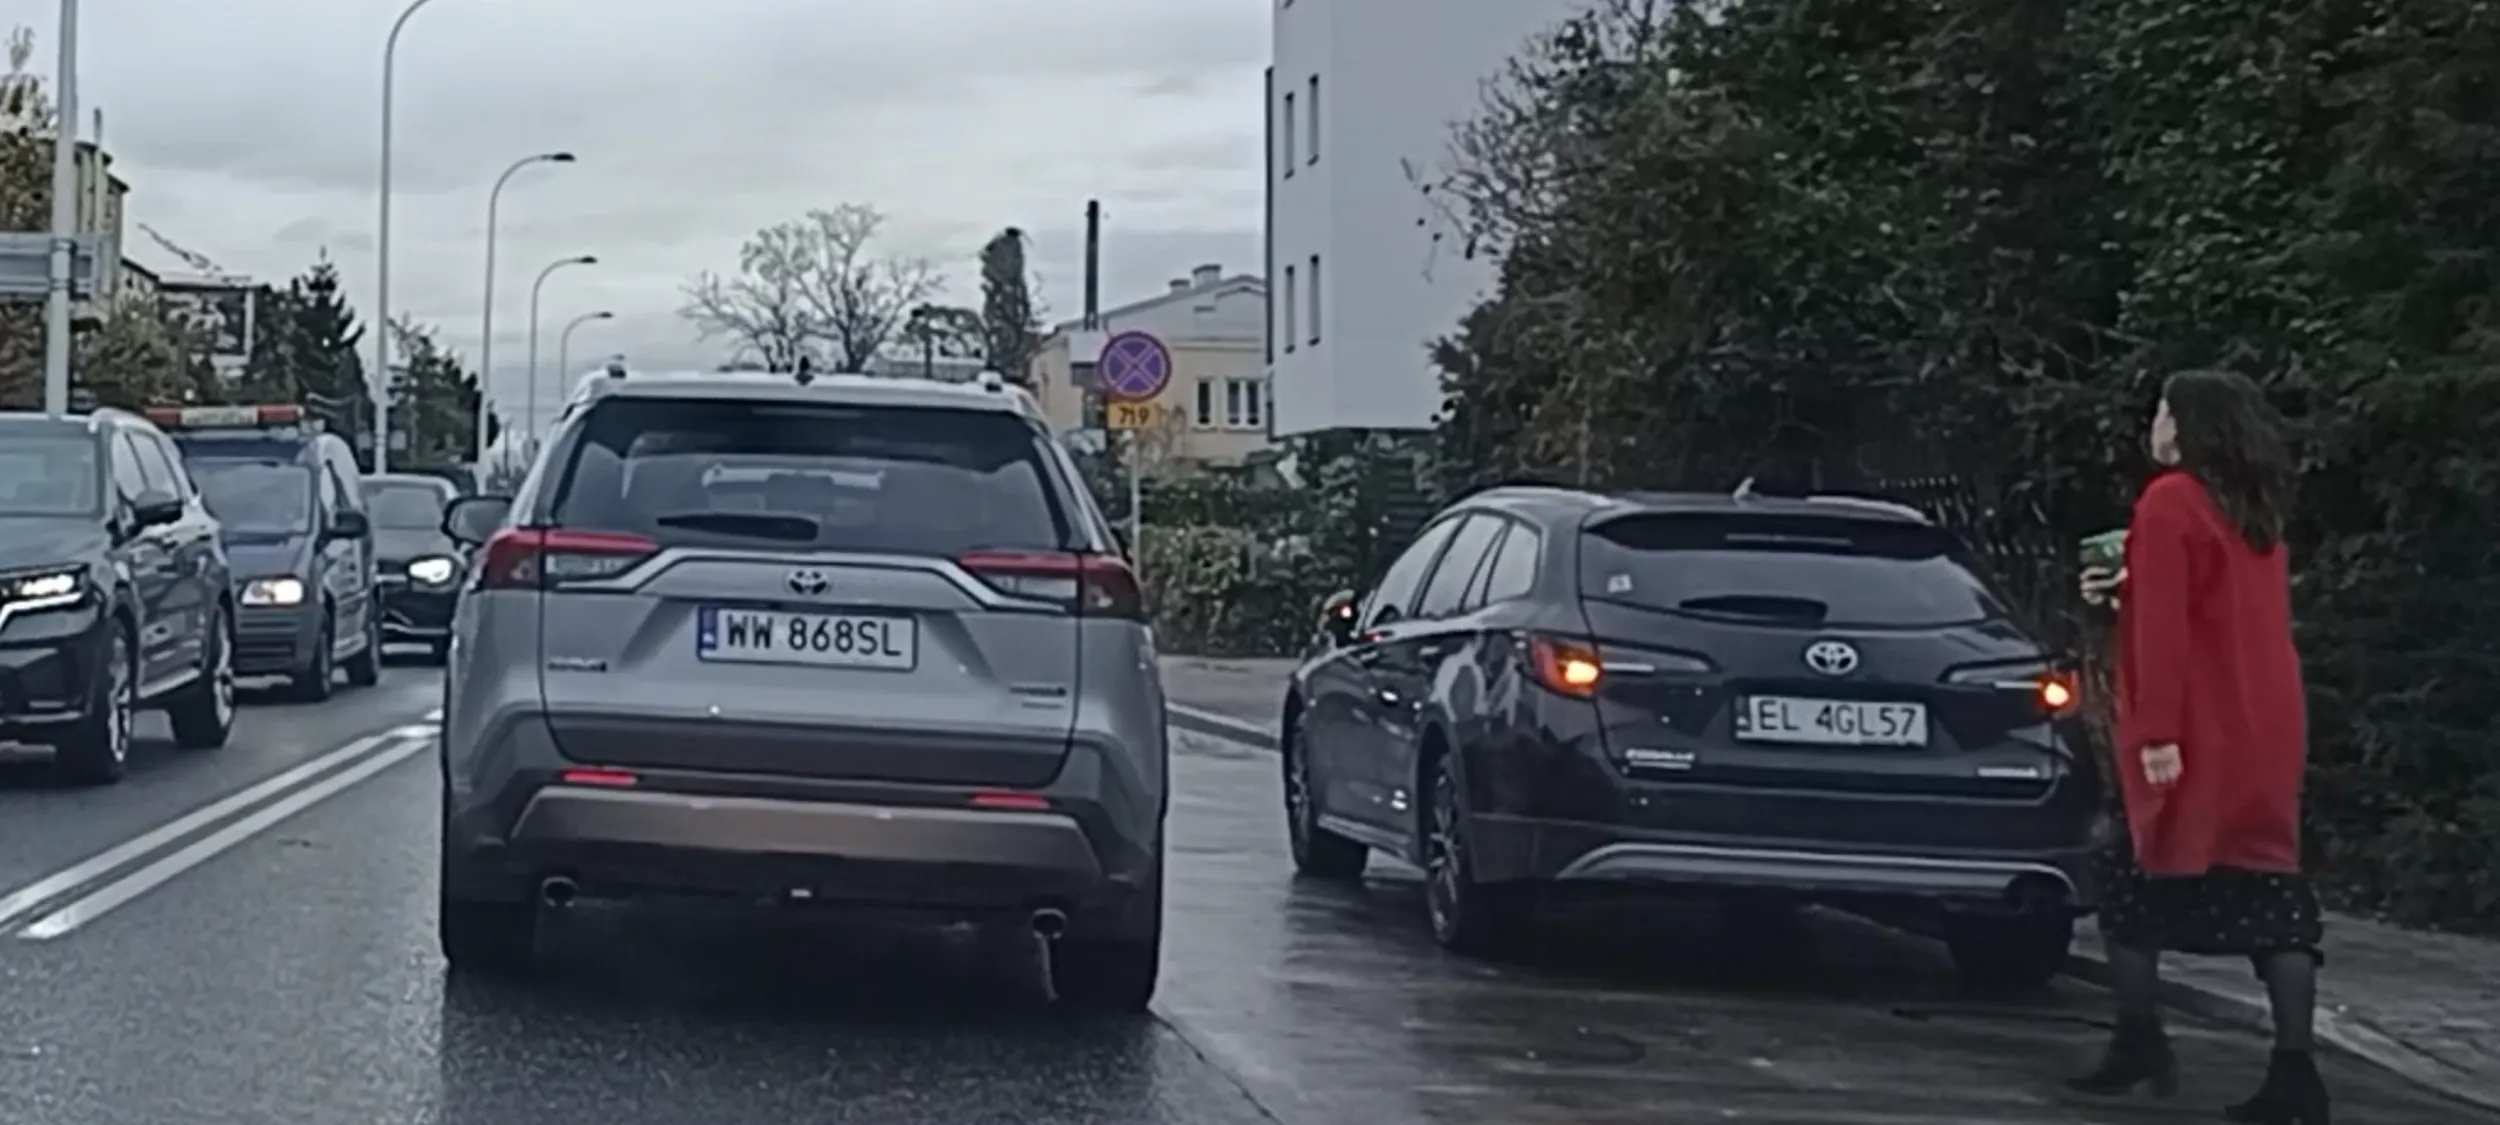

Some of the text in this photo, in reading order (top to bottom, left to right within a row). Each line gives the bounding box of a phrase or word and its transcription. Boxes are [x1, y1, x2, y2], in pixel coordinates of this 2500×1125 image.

[1118, 406, 1150, 425] 719
[727, 614, 902, 656] WW 868SL
[1758, 700, 1917, 737] EL 4GL57
